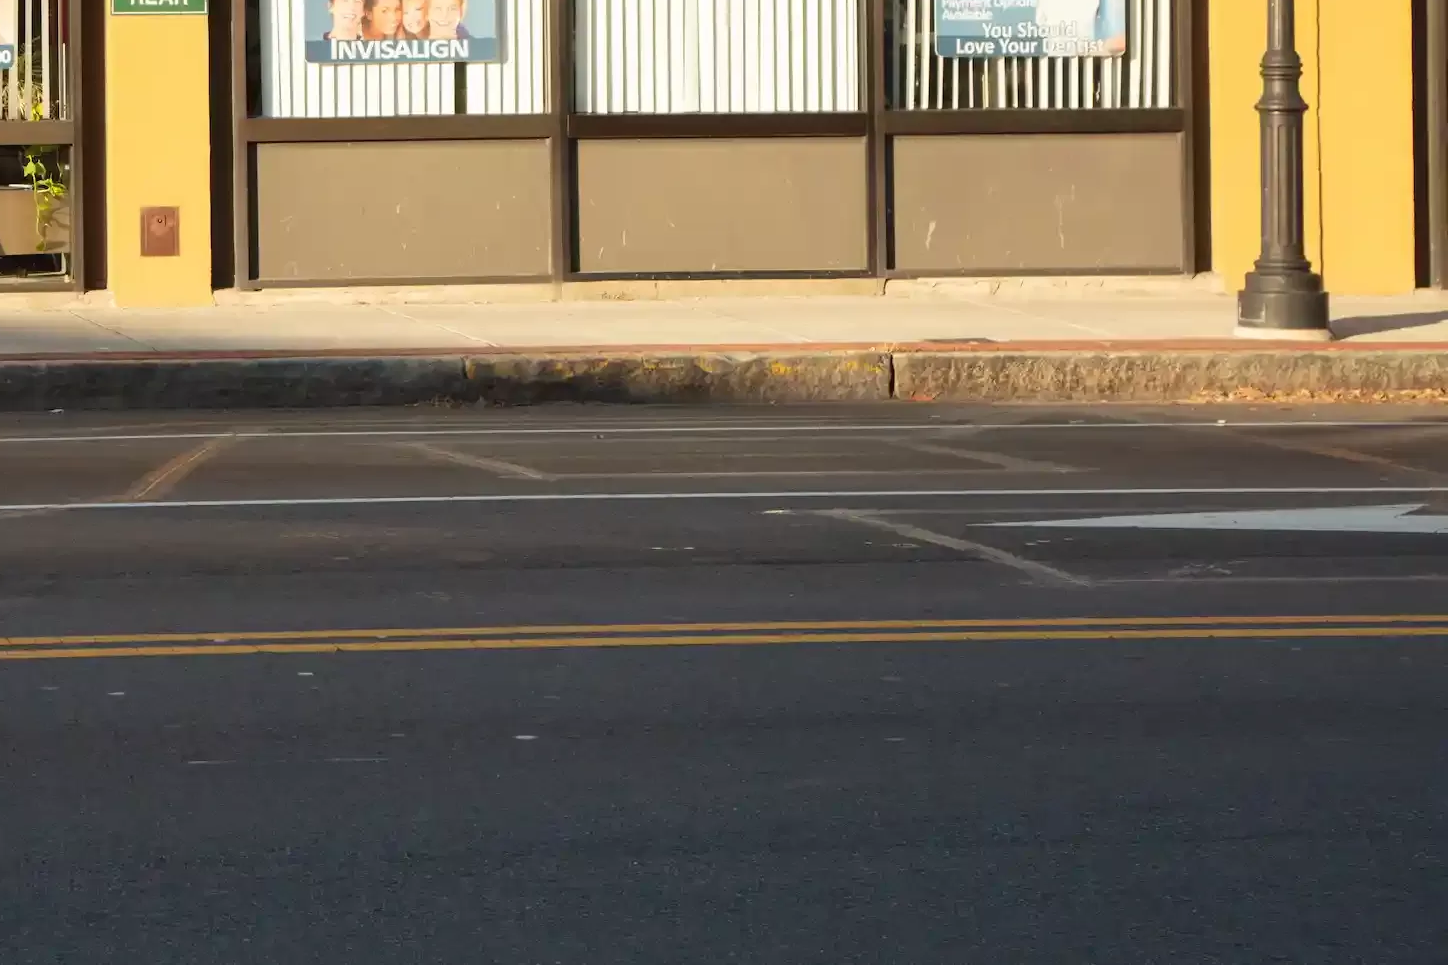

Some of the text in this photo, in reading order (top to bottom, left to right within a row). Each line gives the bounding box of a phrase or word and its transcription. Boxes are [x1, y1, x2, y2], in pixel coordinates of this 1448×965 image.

[982, 20, 1077, 38] You Should
[330, 39, 469, 60] INVISALIGN
[956, 38, 1104, 55] Love Your Dentist
